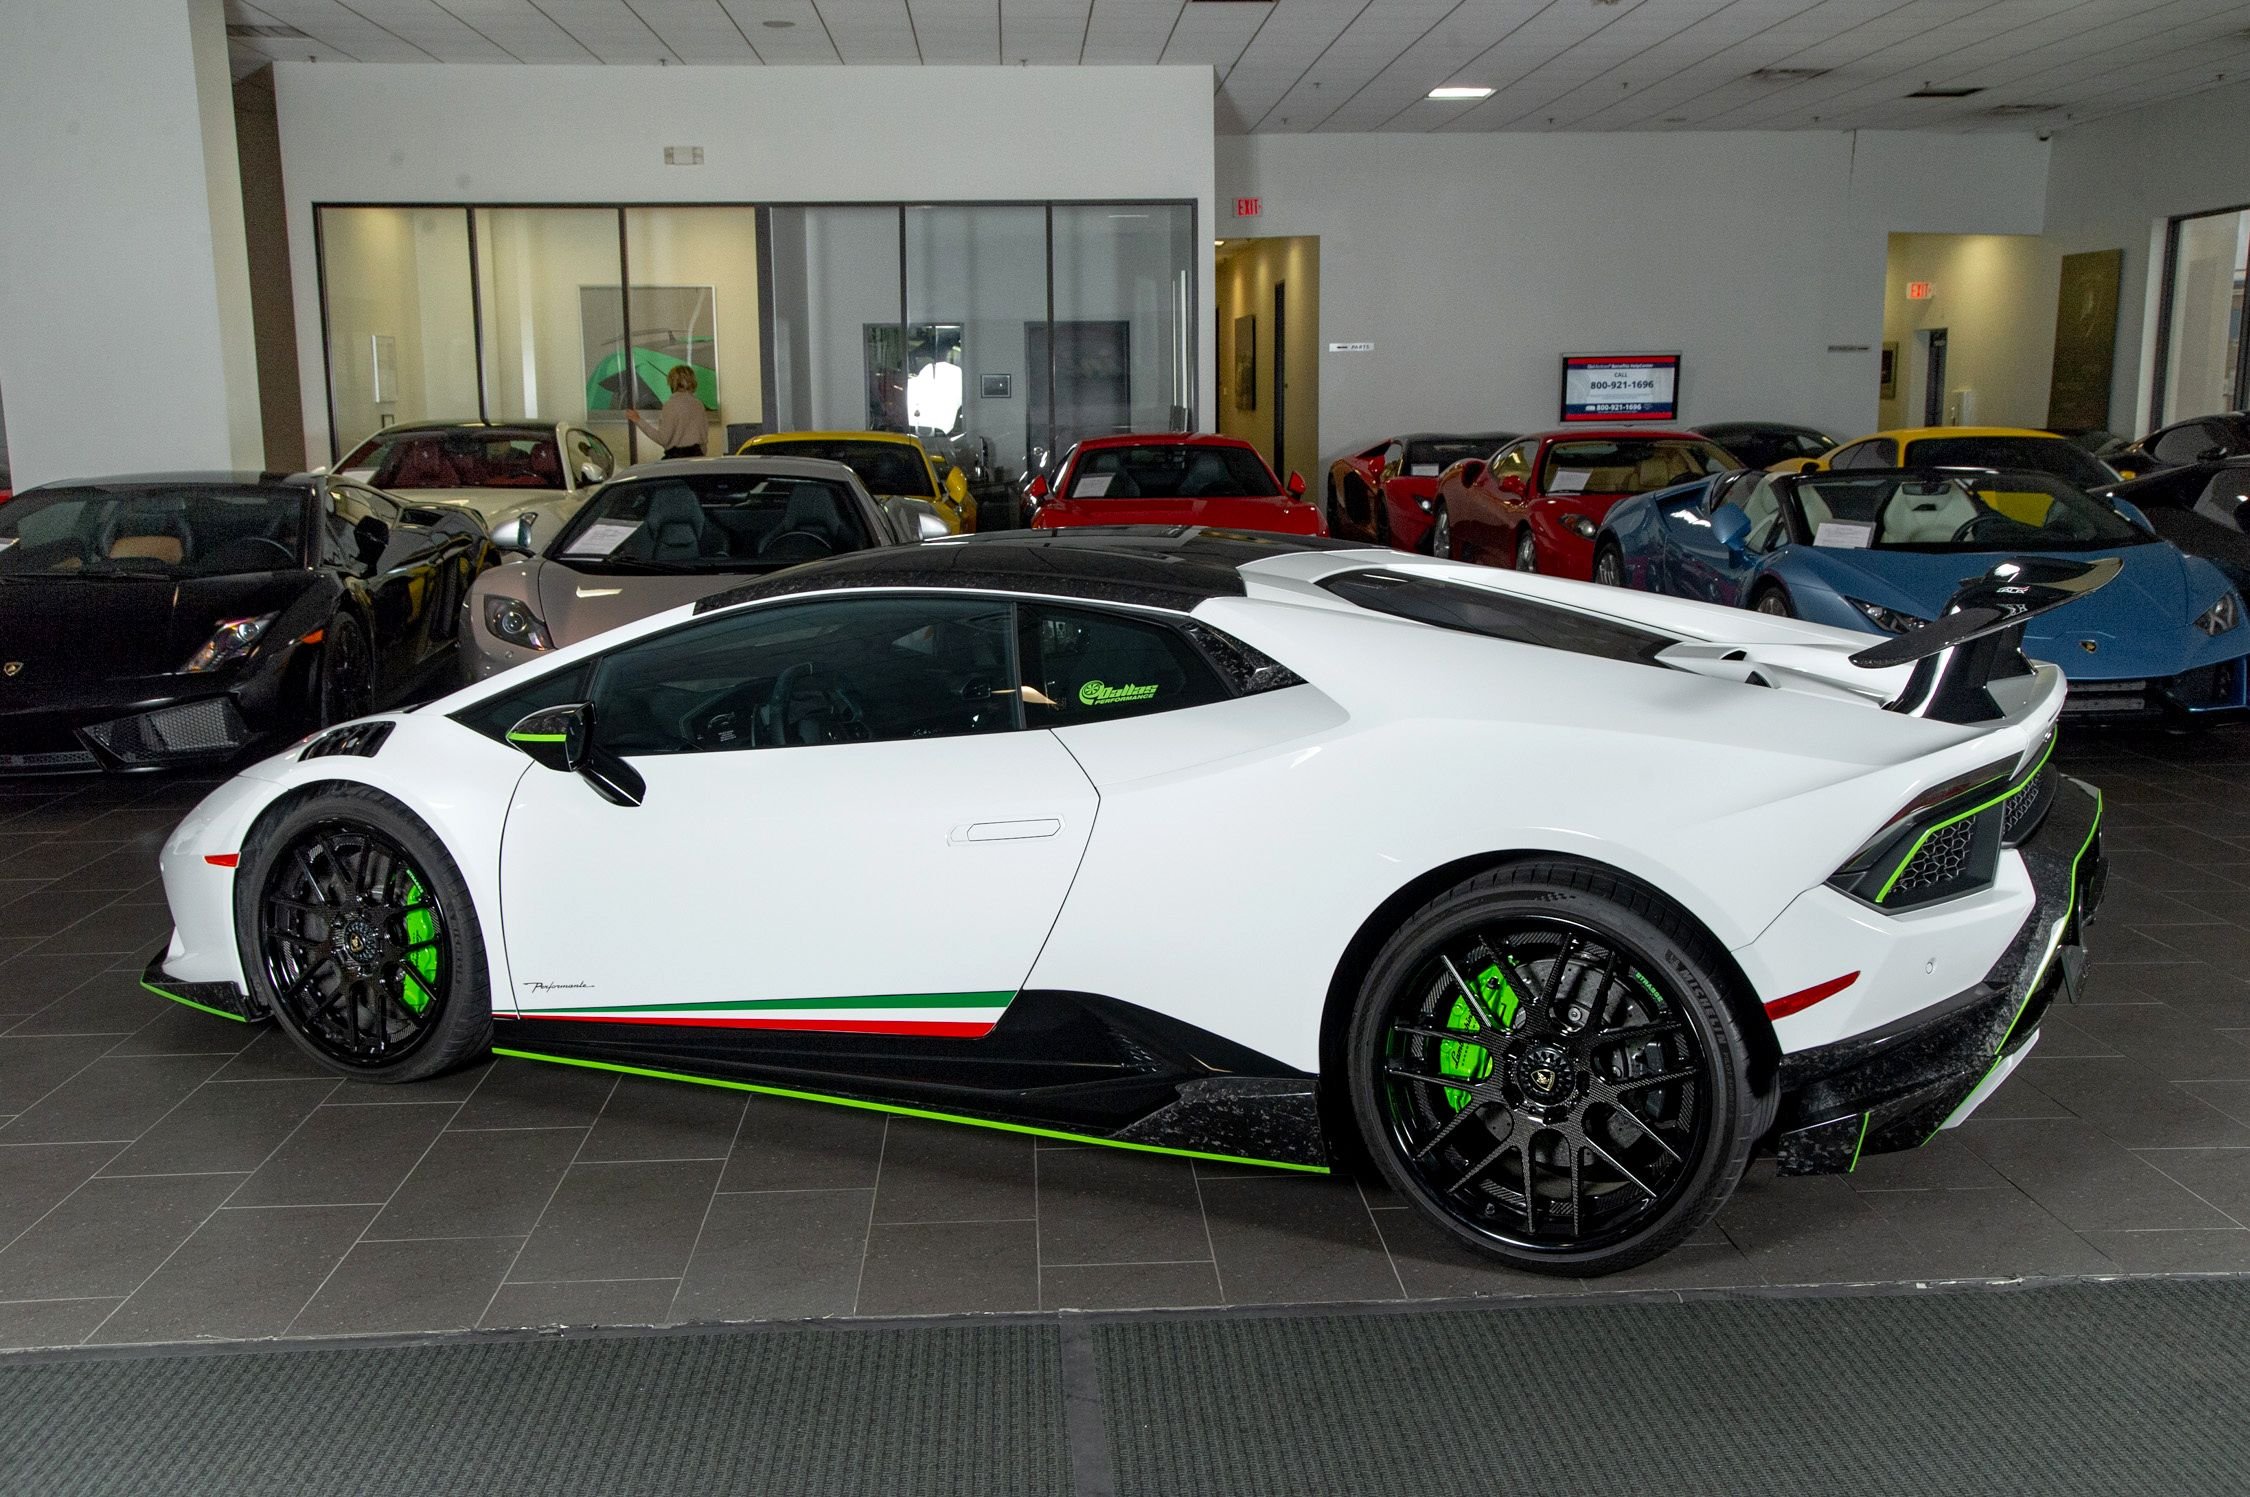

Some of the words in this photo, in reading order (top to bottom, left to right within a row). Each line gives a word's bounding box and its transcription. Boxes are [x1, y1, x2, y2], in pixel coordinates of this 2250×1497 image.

[1237, 199, 1259, 216] EXIT
[1911, 283, 1929, 298] EXIT
[1590, 380, 1654, 390] 800-921-1696
[1094, 693, 1155, 705] PERFORMANCE
[1096, 683, 1159, 700] Dallas
[523, 980, 596, 994] Performante
[1634, 971, 1664, 1003] STRASSE
[1680, 966, 1727, 1045] MICHELIN
